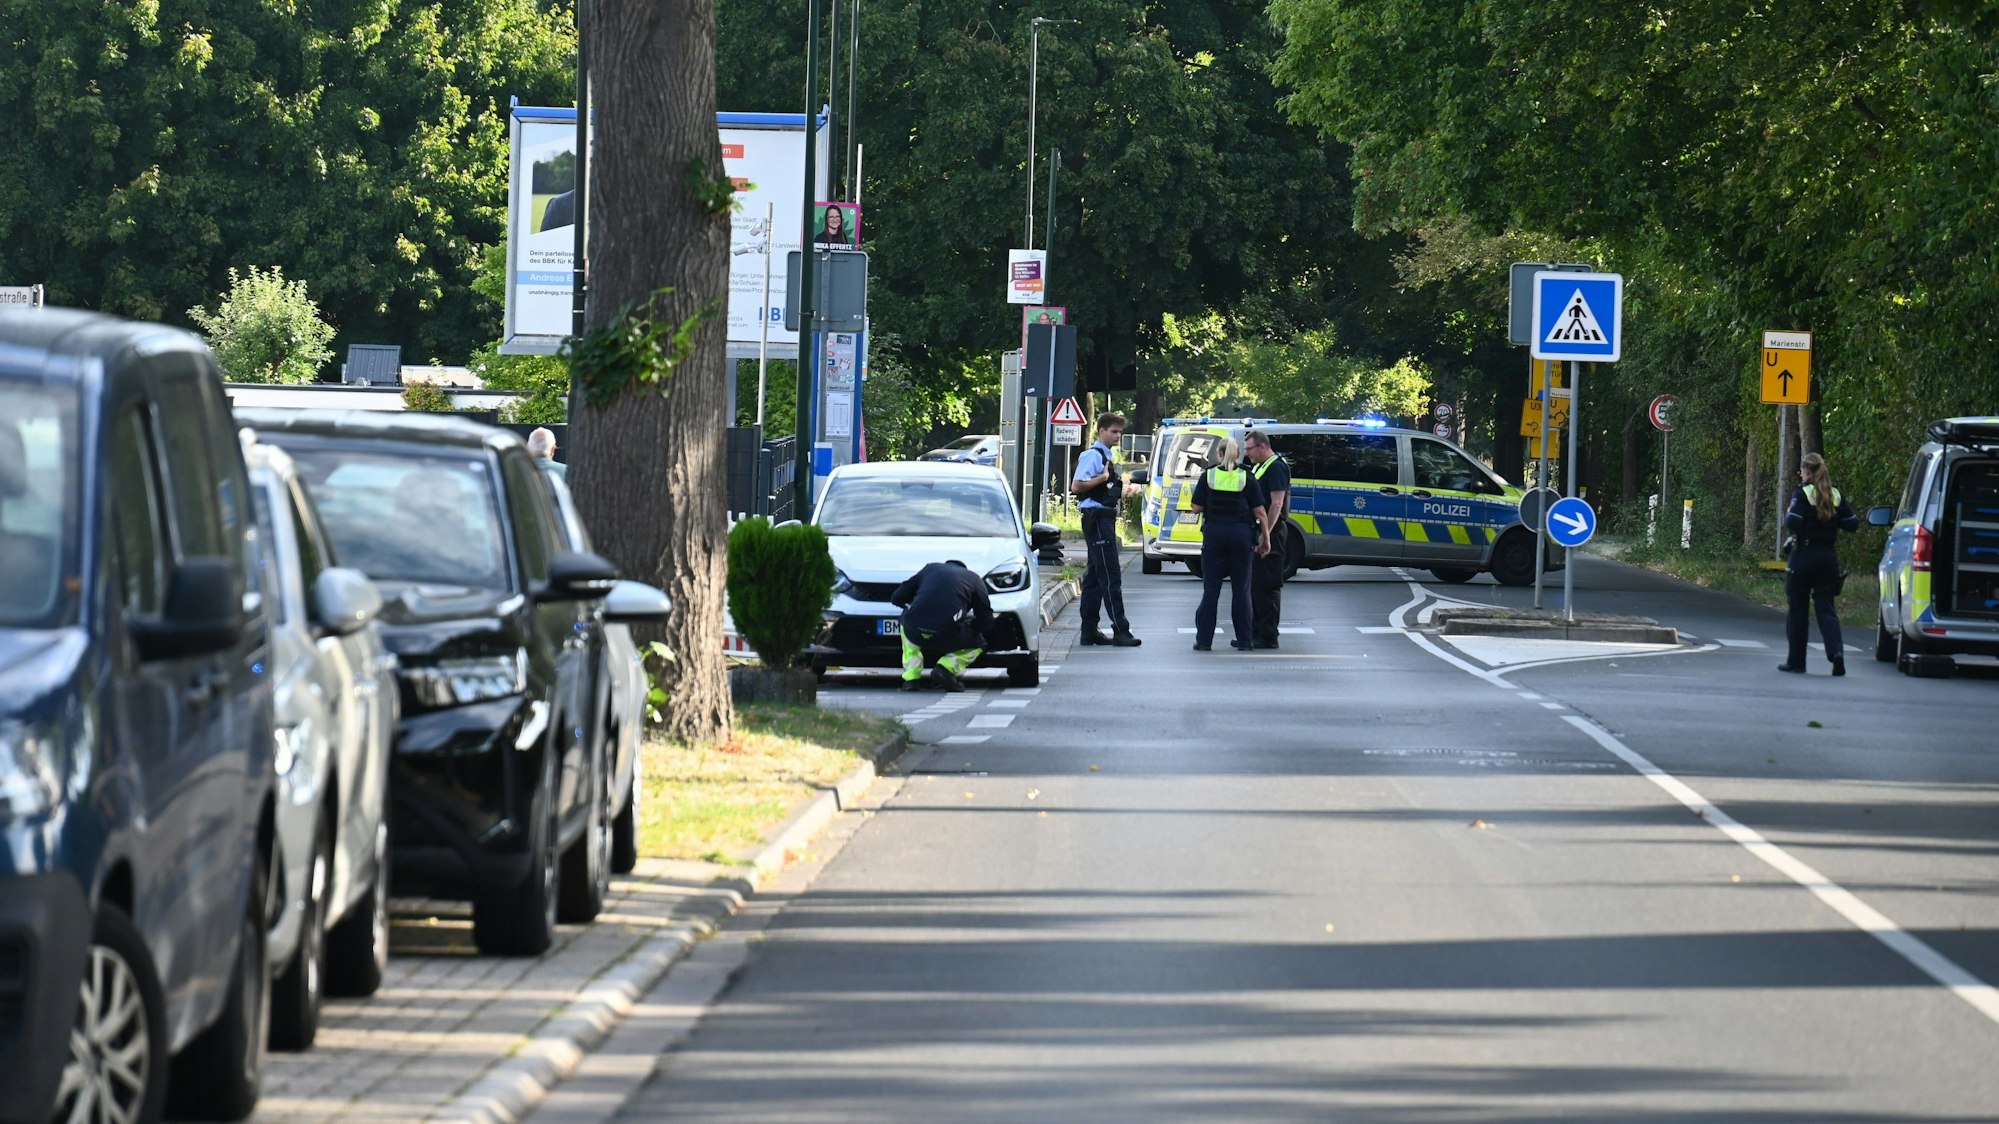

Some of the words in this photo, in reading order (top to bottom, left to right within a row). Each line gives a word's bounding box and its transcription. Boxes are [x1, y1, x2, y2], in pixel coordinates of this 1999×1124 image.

[530, 273, 564, 282] Andreas
[1766, 352, 1778, 367] U
[1550, 399, 1557, 408] U
[1056, 427, 1077, 436] Radweg-
[1423, 502, 1470, 517] POLIZEI
[884, 620, 901, 633] BM
